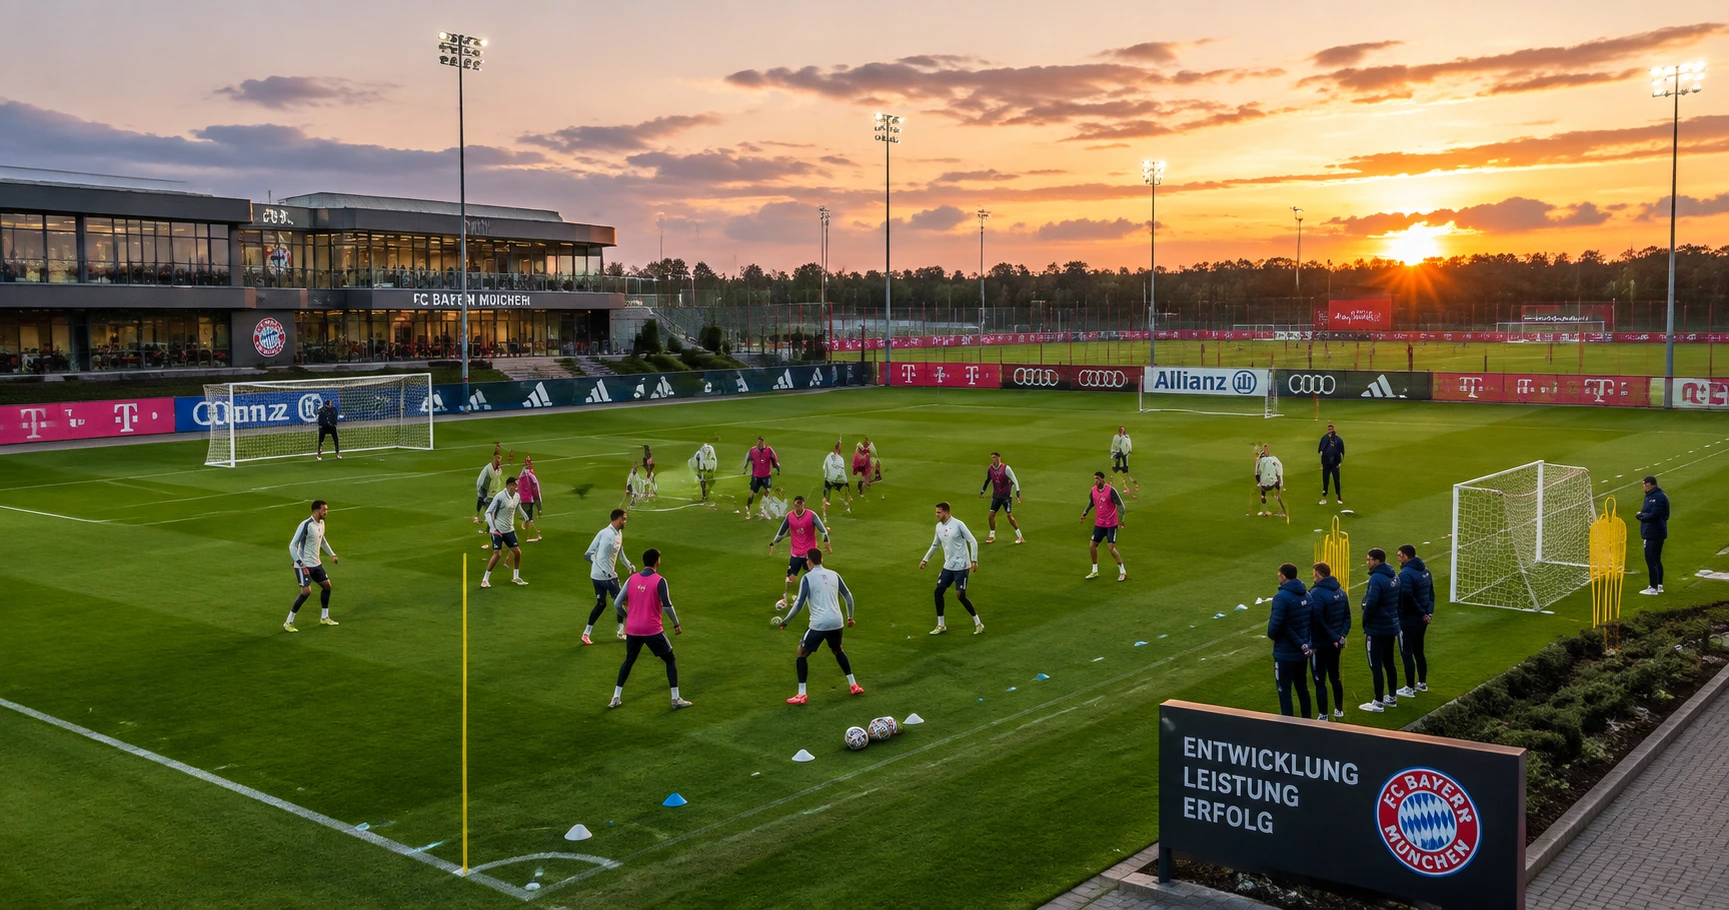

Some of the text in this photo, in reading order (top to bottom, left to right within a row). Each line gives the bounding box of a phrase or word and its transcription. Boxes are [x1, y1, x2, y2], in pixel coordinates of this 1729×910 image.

[1154, 370, 1227, 391] Allianz
[1183, 735, 1359, 786] ENTWICKLUNG
[1183, 766, 1299, 808] LEISTUNG
[1383, 774, 1473, 823] FC BAYERN
[1183, 796, 1274, 835] ERFOLG
